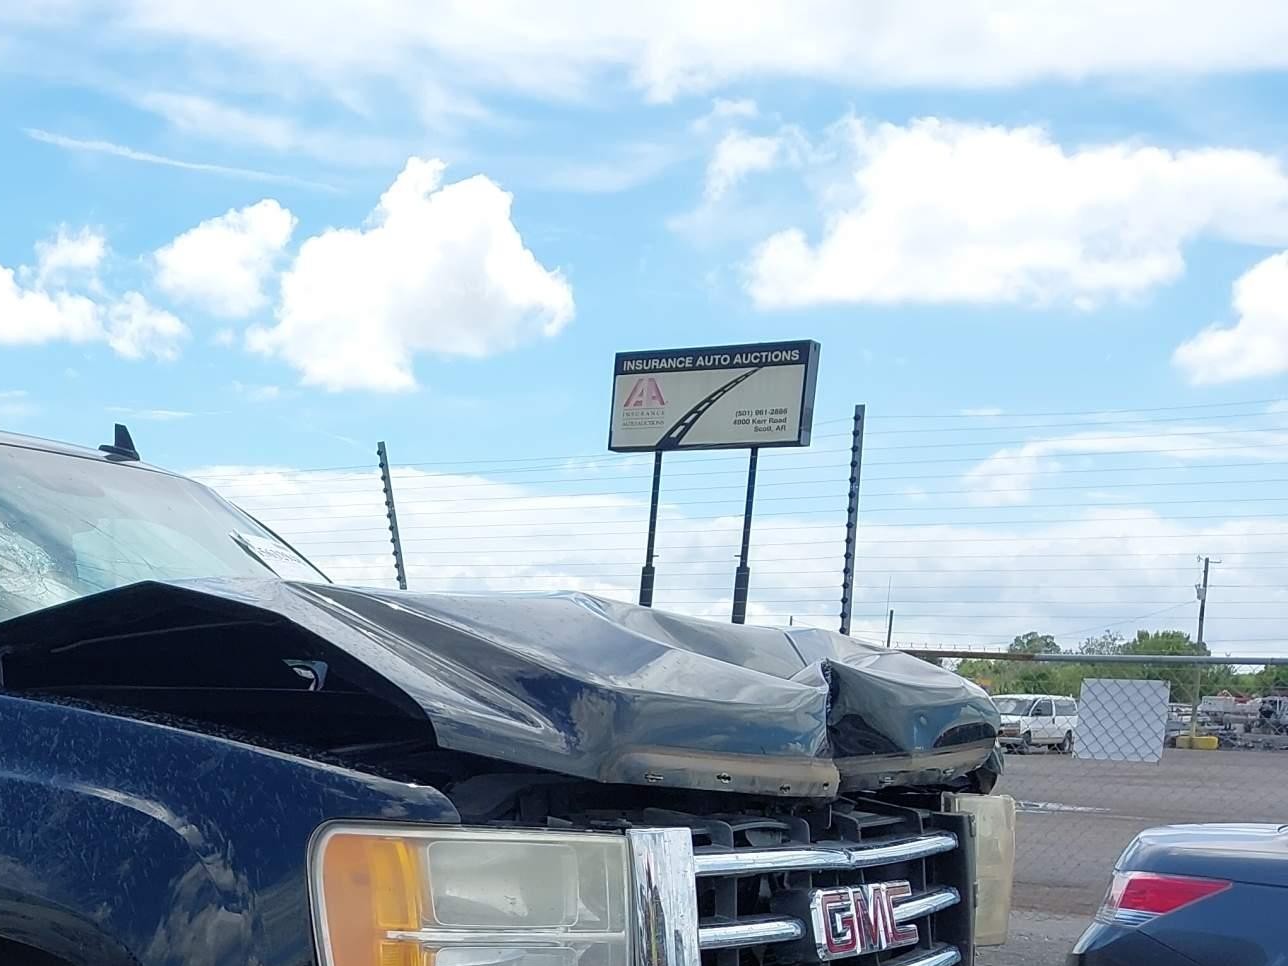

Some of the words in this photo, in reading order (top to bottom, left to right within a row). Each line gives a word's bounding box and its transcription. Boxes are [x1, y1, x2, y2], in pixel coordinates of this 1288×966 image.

[623, 356, 693, 371] INSURANCE
[695, 354, 730, 367] AUTO
[733, 349, 800, 365] AUCTIONS
[810, 880, 919, 961] GMC
